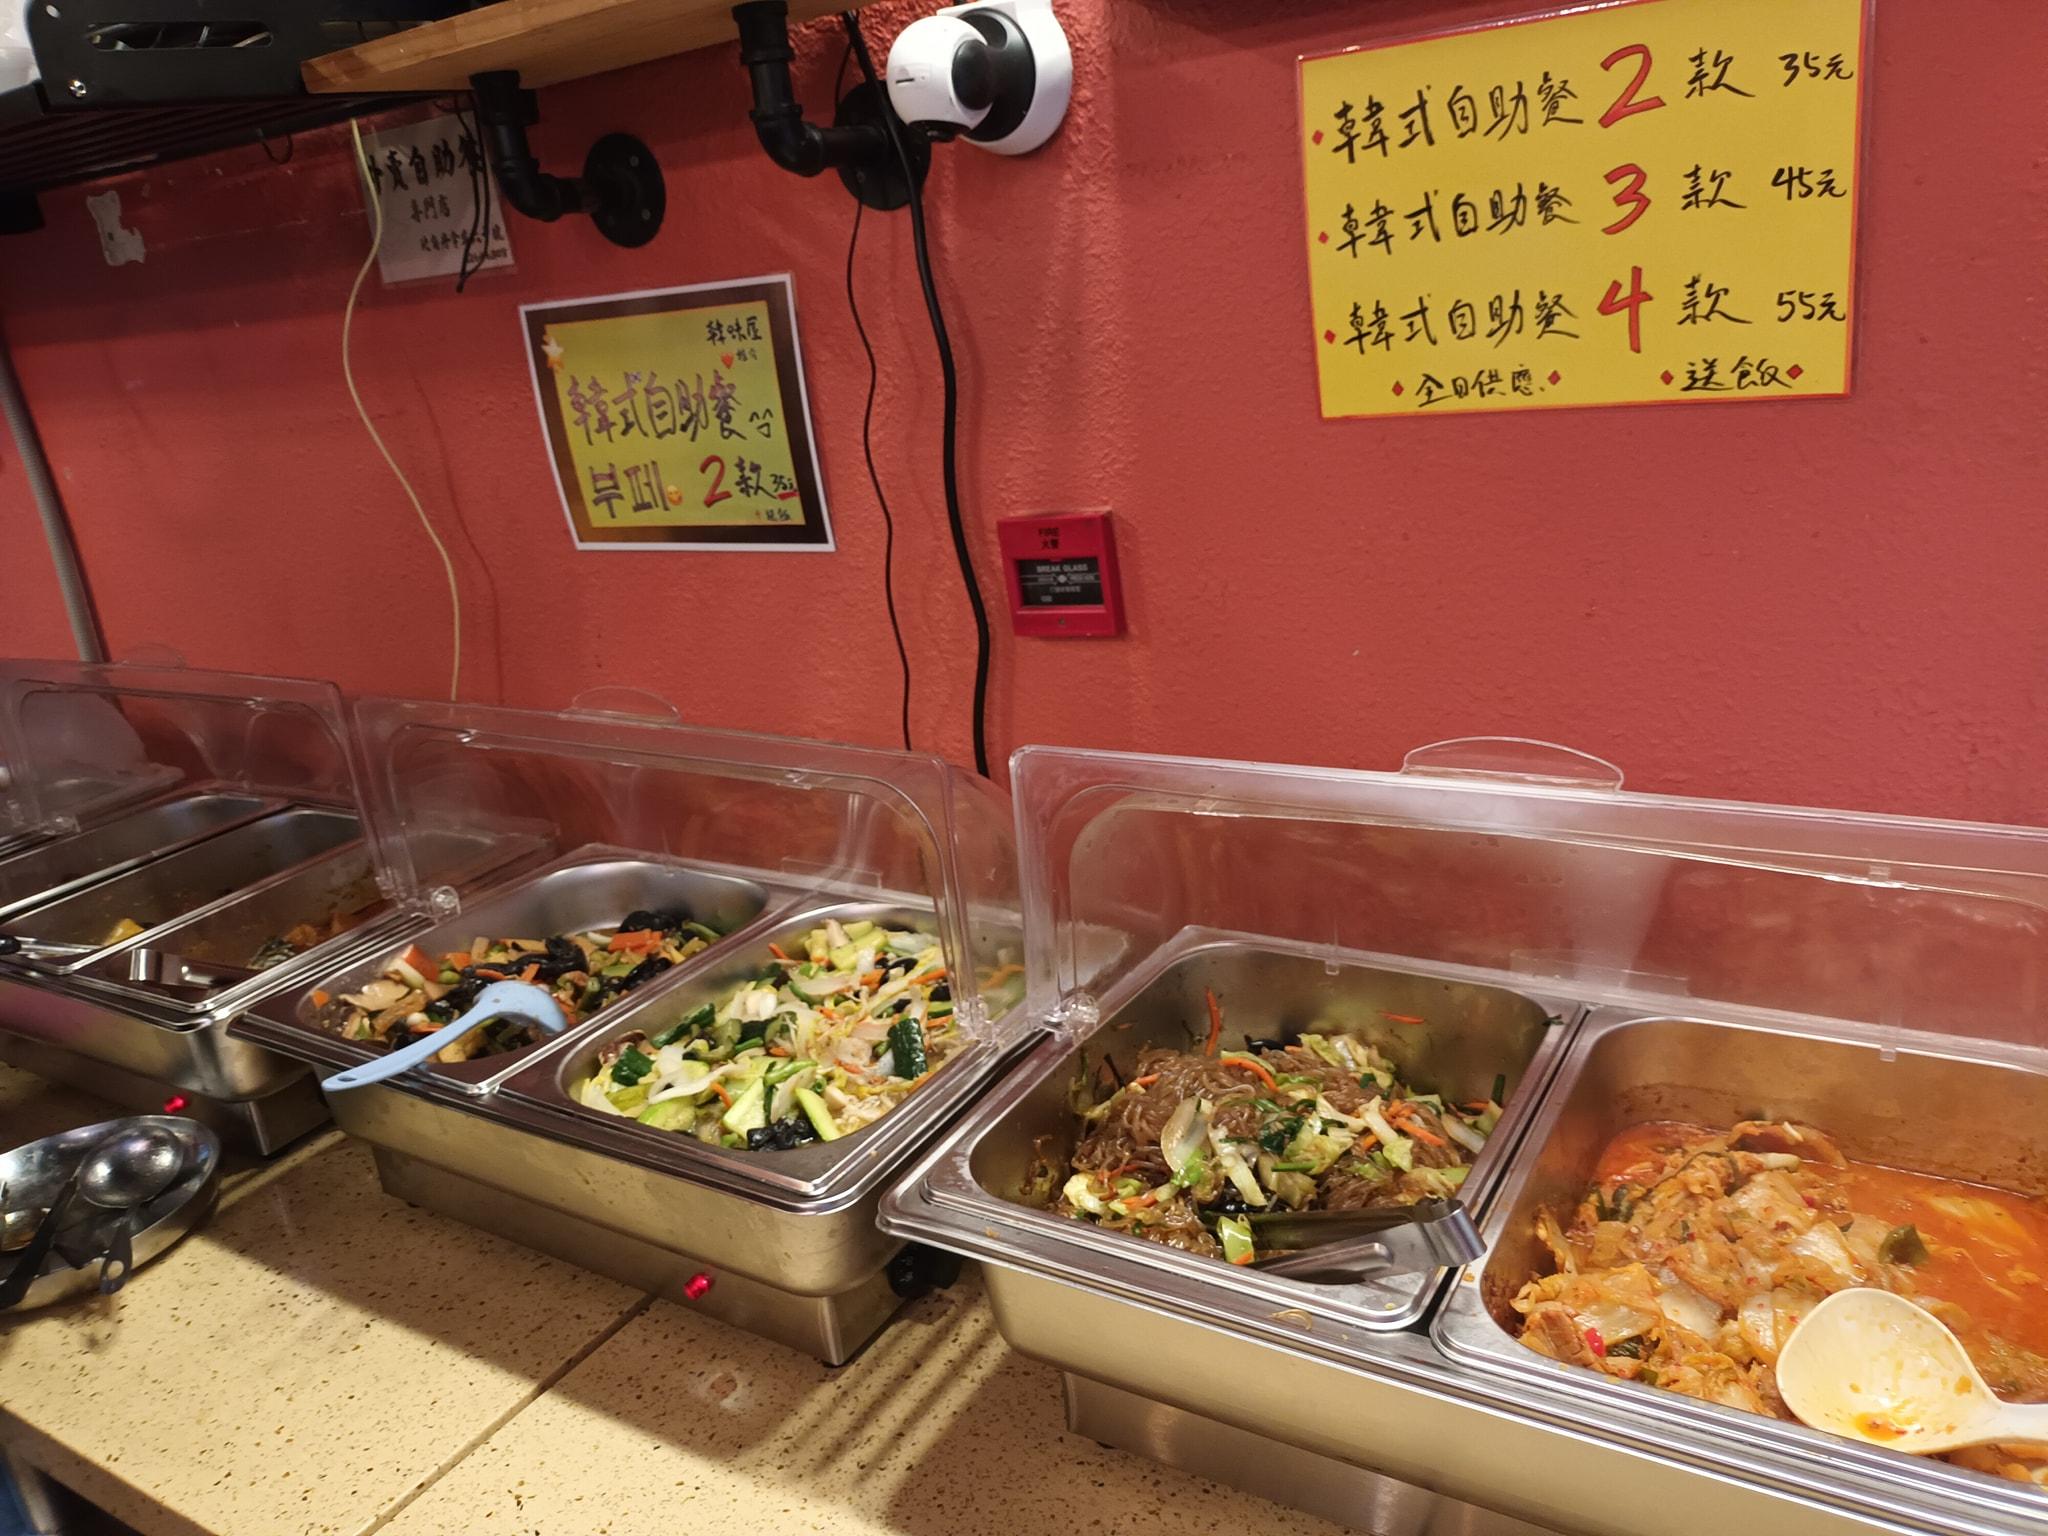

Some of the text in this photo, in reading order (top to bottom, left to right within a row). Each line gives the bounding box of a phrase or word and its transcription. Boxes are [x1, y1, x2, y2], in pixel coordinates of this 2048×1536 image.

[1332, 44, 1855, 163] 韓式自助餐 2 款 35元
[1336, 163, 1848, 258] 韓式自助餐 3 款 45元
[706, 316, 763, 346] 韓味屋
[1343, 266, 1848, 355] 韓式自助餐 4 款 55元
[567, 369, 748, 446] 韓式自助餐
[590, 460, 671, 519] 부페
[700, 455, 733, 508] 2
[735, 456, 778, 500] 款
[1062, 563, 1089, 571] GLASS
